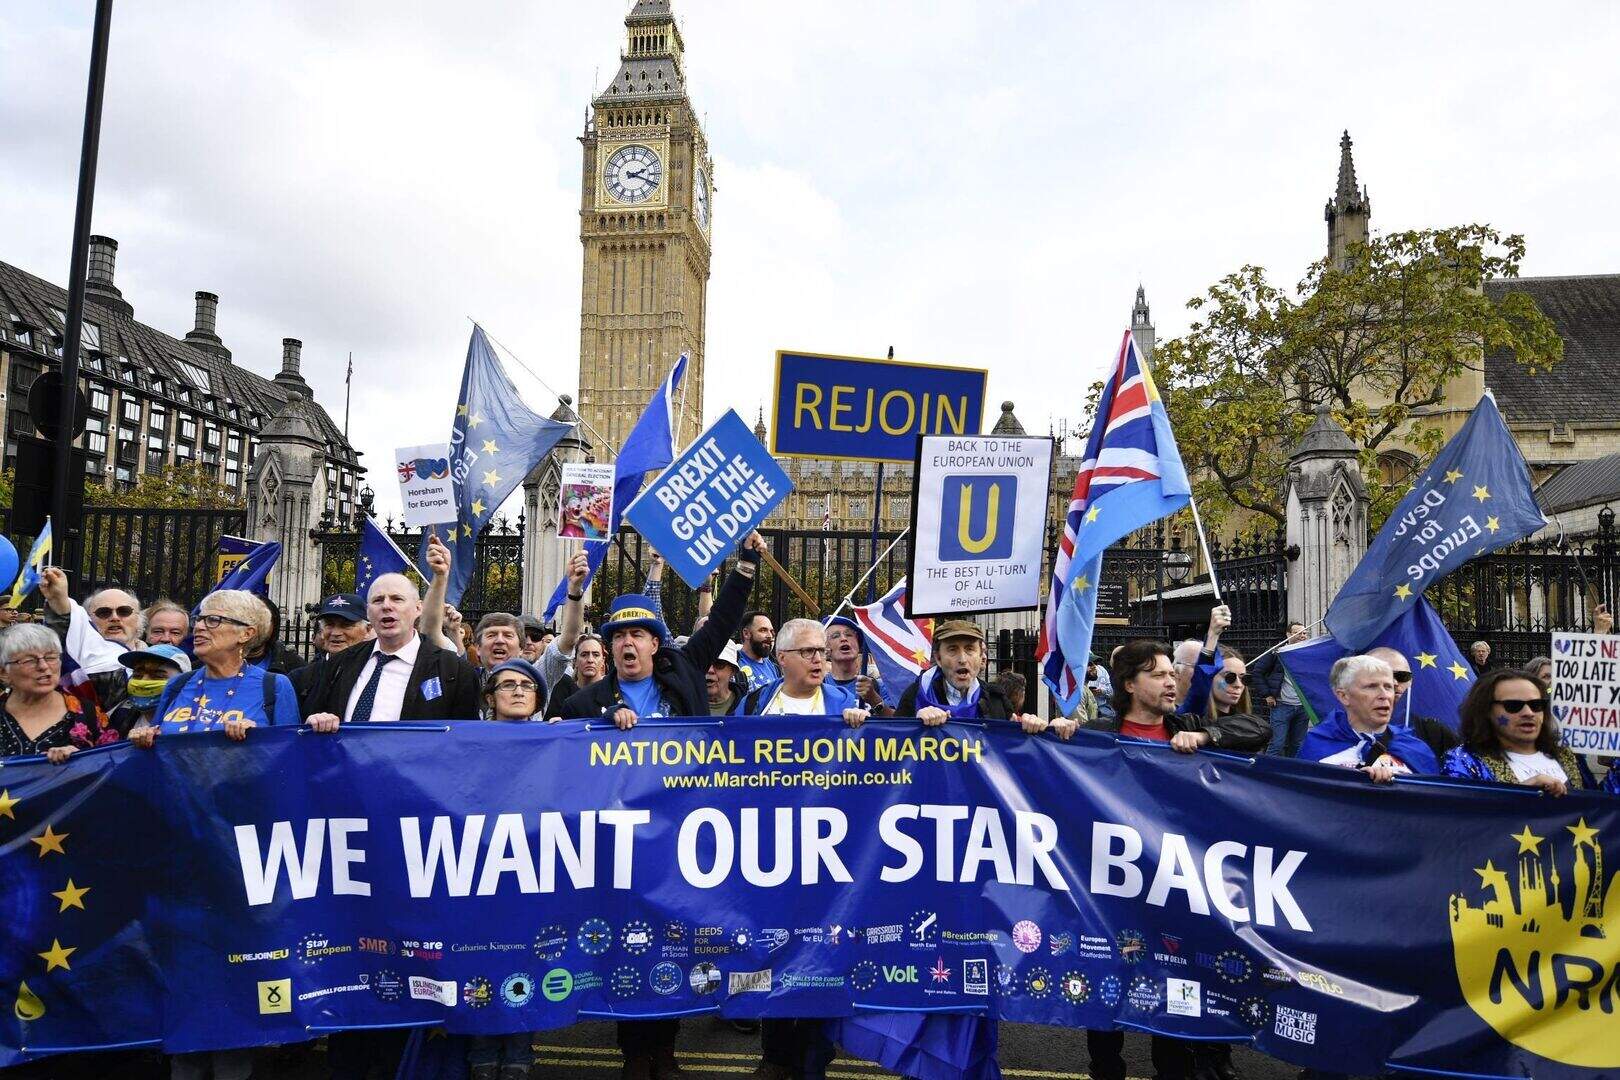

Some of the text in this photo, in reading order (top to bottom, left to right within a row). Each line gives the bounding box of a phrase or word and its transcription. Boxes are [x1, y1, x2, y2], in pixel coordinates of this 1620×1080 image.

[794, 382, 968, 435] REJOIN
[949, 441, 1022, 452] BACK TO THE
[933, 456, 1034, 468] EUROPEAN UNION
[655, 437, 728, 513] BREXIT
[408, 487, 444, 497] Horsham
[671, 454, 755, 541] GOT THE
[408, 498, 449, 509] for Europe
[686, 475, 776, 567] UK DONE
[926, 564, 1027, 579] THE BEST U-TURN
[955, 579, 994, 591] OF ALL
[950, 596, 996, 607] #RejoinEU
[1555, 660, 1616, 681] TOO LATE
[1553, 682, 1602, 703] ADMIT
[1567, 706, 1620, 728] MISTA
[590, 737, 984, 766] NATIONAL REJOIN MARCH
[663, 769, 912, 790] www.MarchForRejoin.co.uk
[234, 804, 1313, 933] WE WANT OUR STAR BACK
[694, 927, 723, 936] LEEDS
[794, 927, 823, 935] Scientists
[942, 931, 999, 941] #BrexitCarnage
[306, 940, 328, 949] Stay
[359, 938, 388, 952] SMR
[402, 940, 443, 950] we are
[867, 934, 902, 944] FOR EUROPE
[1080, 935, 1107, 943] European
[306, 945, 351, 957] European
[451, 942, 527, 952] Catharine Kingcome
[694, 946, 729, 954] EUROPE
[1080, 944, 1112, 952] Movement
[1154, 953, 1169, 962] VIEW
[1170, 955, 1187, 965] DELTA
[882, 965, 919, 983] Volt
[1263, 973, 1291, 982] WOMEN
[298, 989, 334, 1001] CORNWALL
[1207, 1007, 1230, 1016] Europe
[1276, 1013, 1317, 1031] FOR THE
[1275, 1022, 1315, 1043] MUSIC
